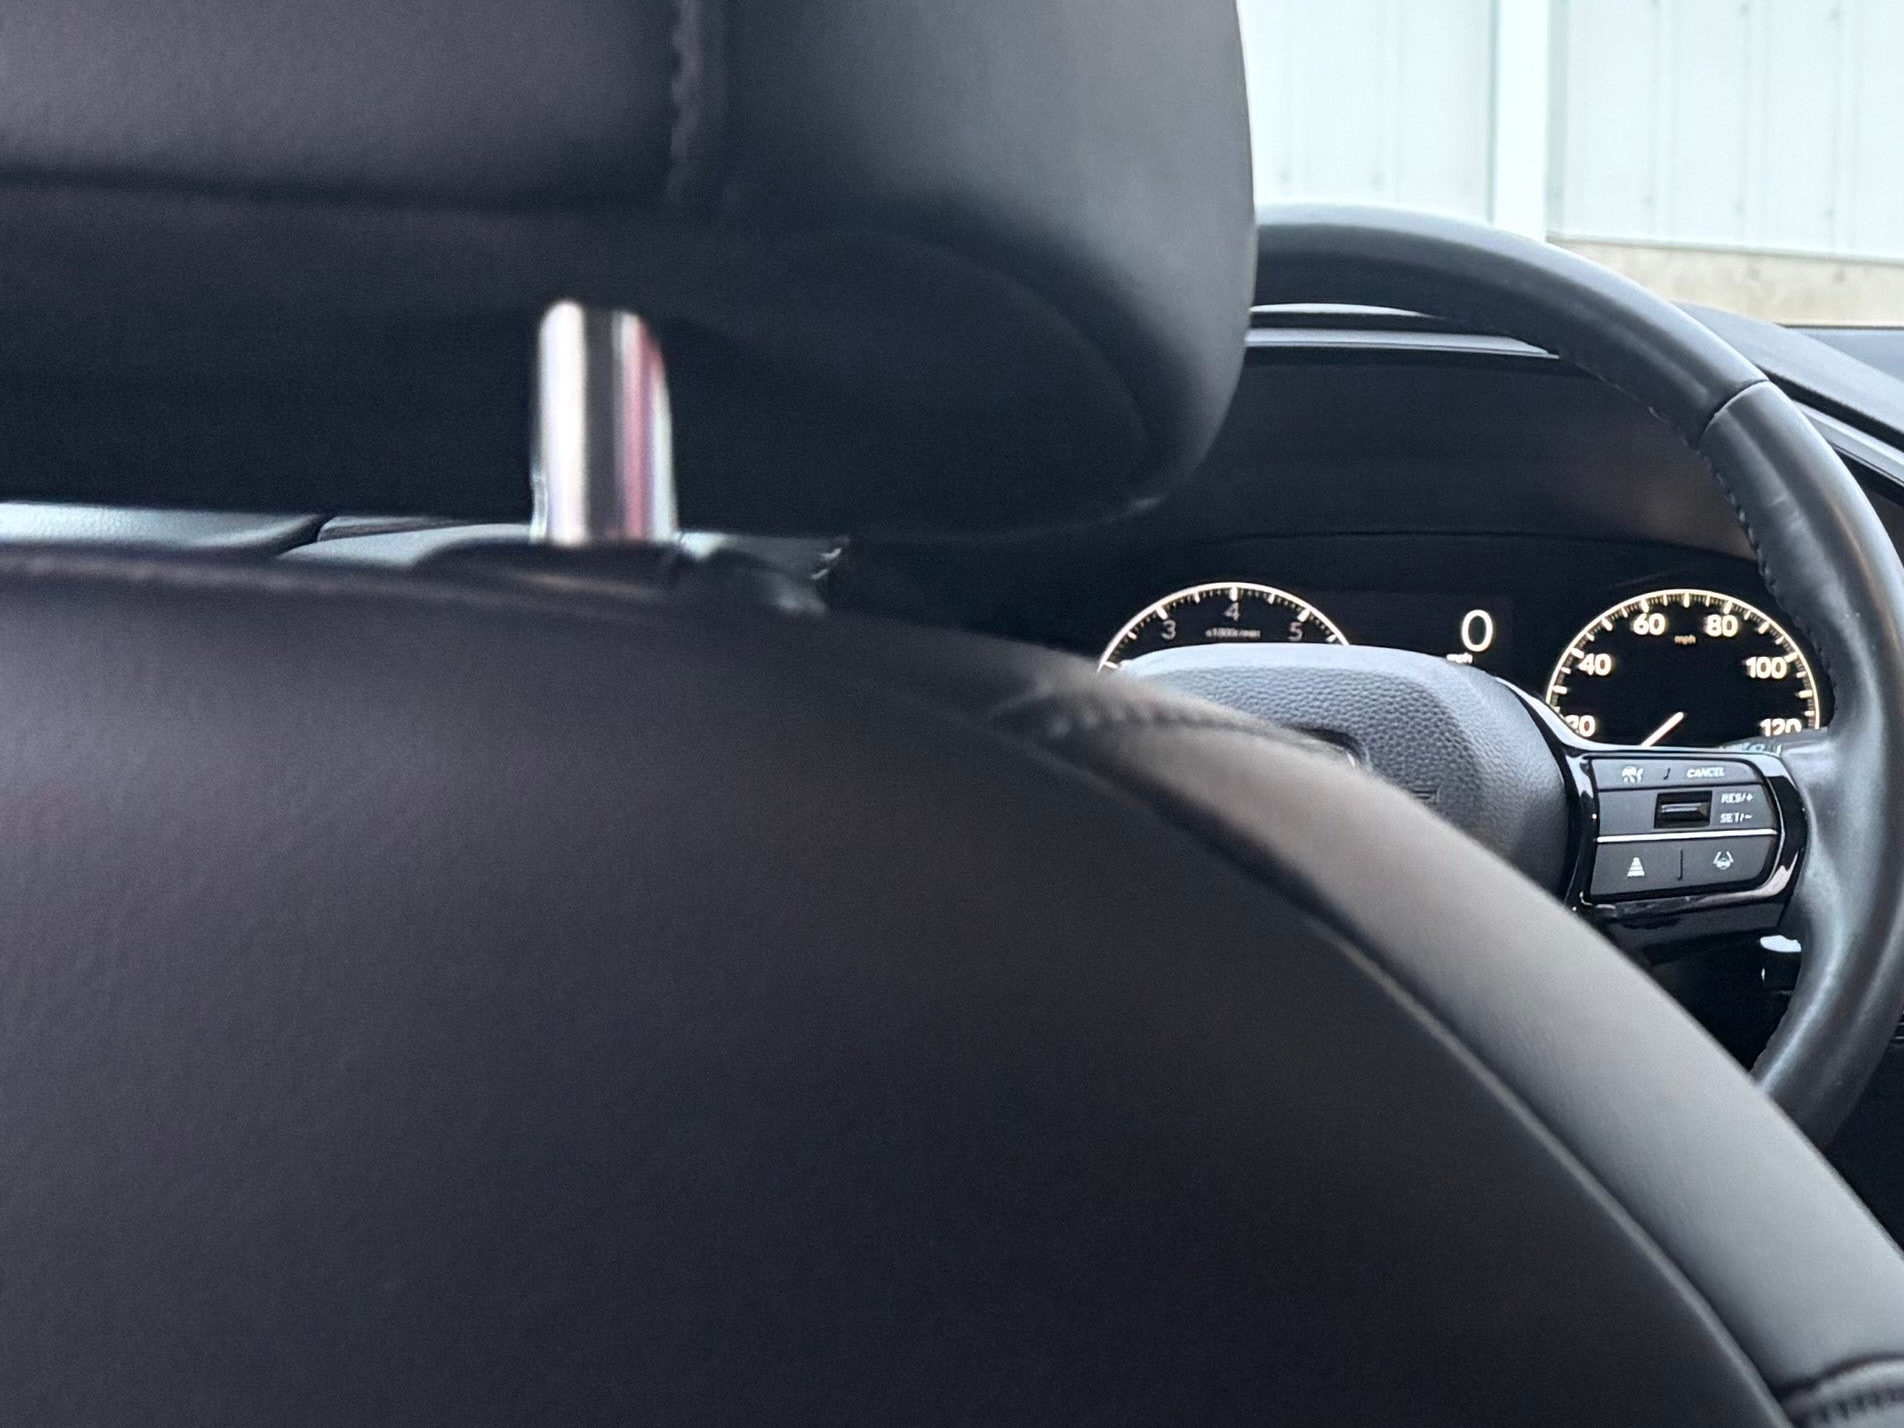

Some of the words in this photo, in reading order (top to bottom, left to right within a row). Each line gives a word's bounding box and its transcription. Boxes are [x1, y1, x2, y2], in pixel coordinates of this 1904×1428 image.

[1223, 602, 1240, 621] 4
[1161, 619, 1177, 640] 3
[1288, 622, 1303, 641] 5
[1461, 609, 1493, 652] 0
[1633, 613, 1667, 636] 60
[1705, 614, 1739, 637] 80
[1674, 634, 1697, 645] mph
[1577, 653, 1613, 676] 40
[1744, 656, 1788, 679] 100
[1760, 718, 1802, 737] 120
[1686, 766, 1725, 779] CANCEL
